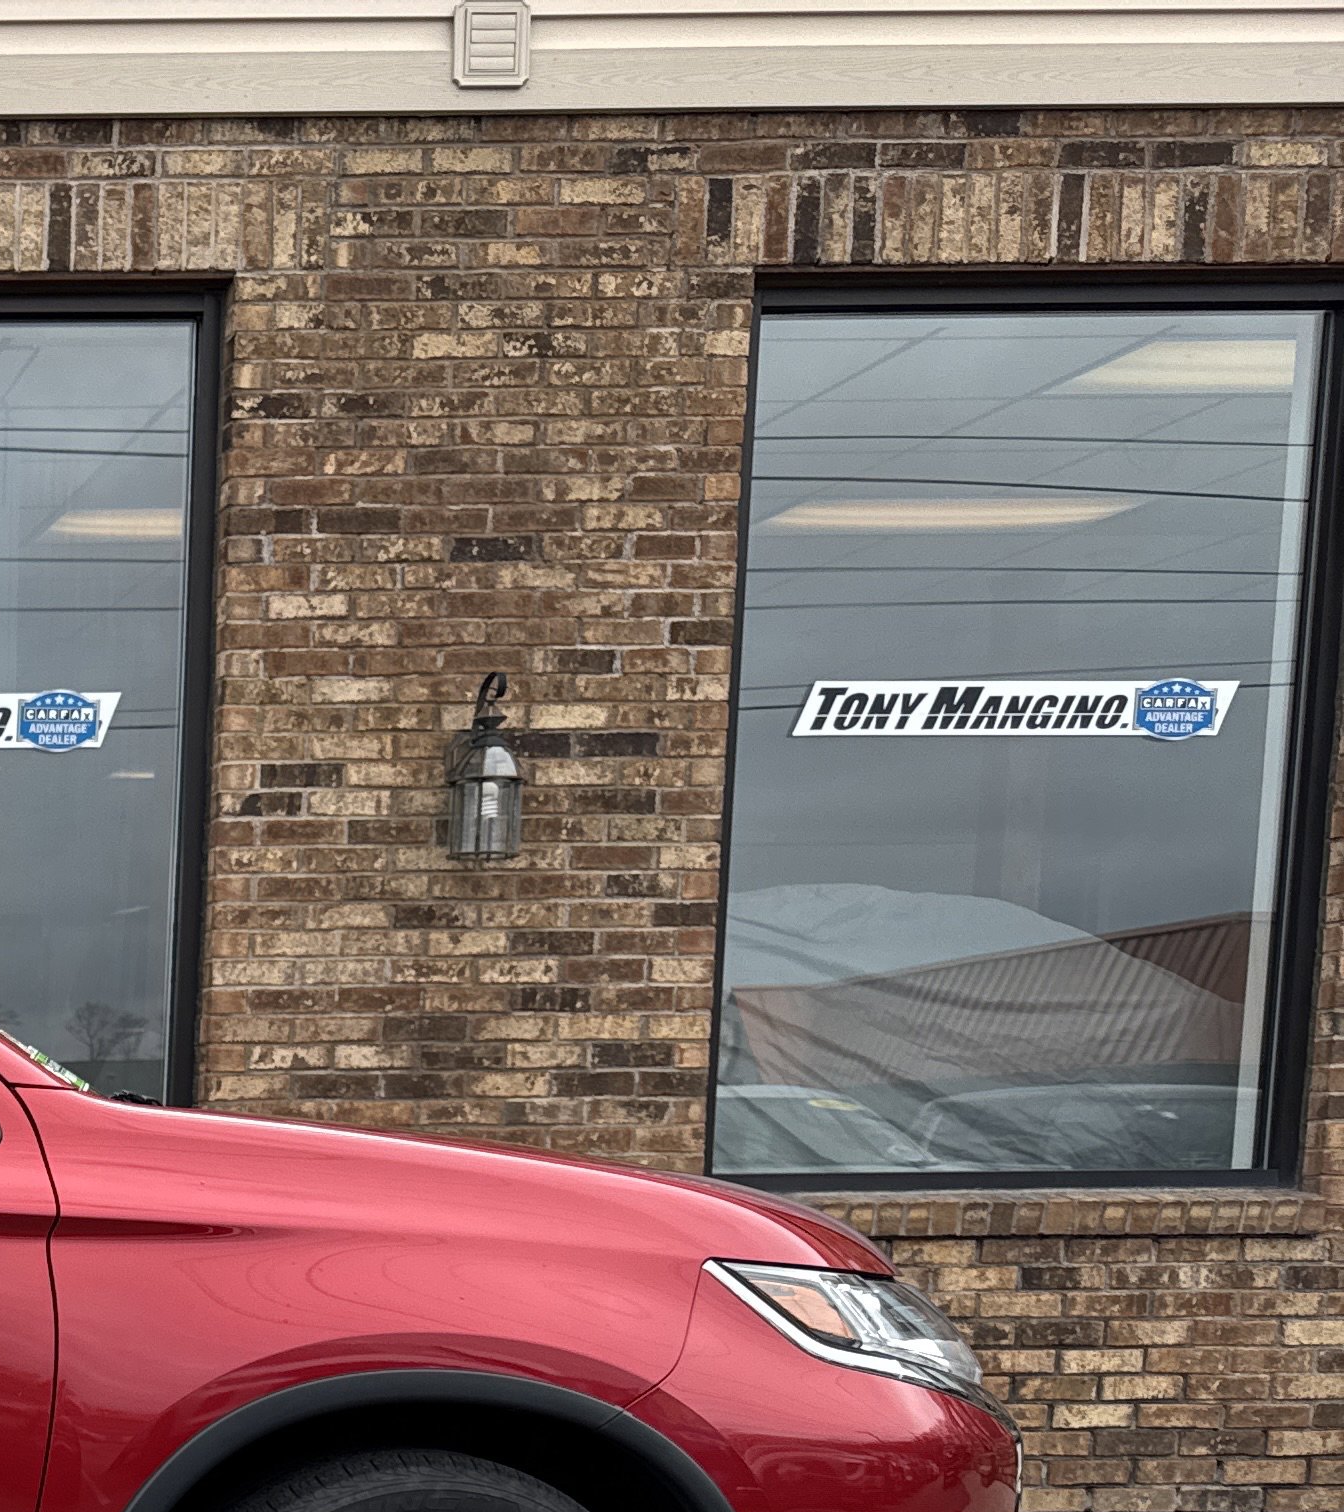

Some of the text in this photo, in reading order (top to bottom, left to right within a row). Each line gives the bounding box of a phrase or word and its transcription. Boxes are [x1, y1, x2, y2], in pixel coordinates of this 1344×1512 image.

[810, 687, 926, 731] TONY
[1141, 696, 1211, 710] CARFAX
[25, 708, 94, 722] CARFAX
[1144, 711, 1205, 724] ADVANTAGE
[28, 722, 88, 735] ADVANTAGE
[1154, 722, 1193, 734] DEALER
[38, 734, 77, 746] DEALER
